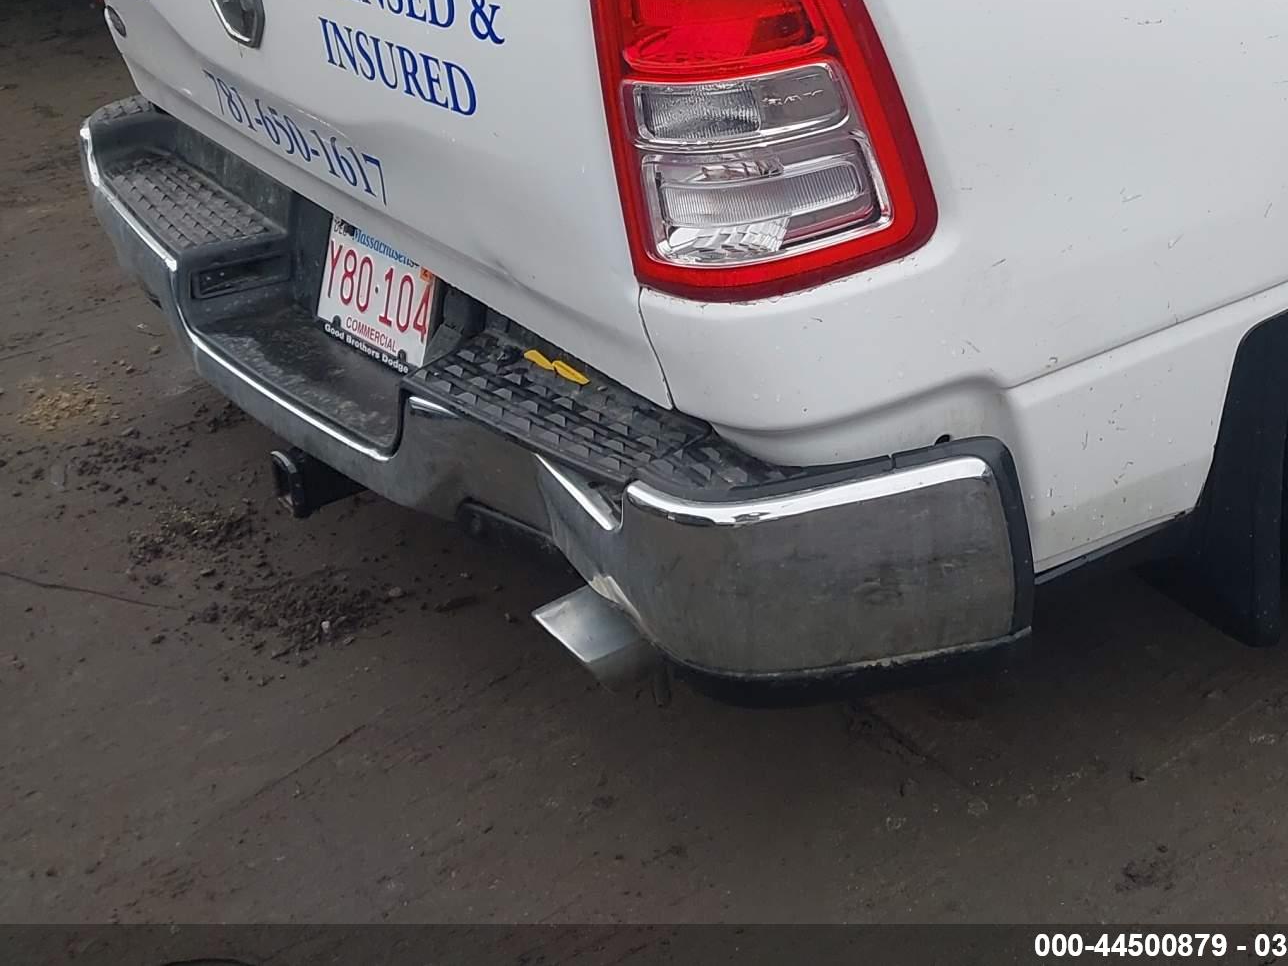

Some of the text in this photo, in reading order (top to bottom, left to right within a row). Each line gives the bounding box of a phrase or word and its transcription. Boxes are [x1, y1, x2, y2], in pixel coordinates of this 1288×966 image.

[318, 17, 477, 116] INSURED
[202, 69, 387, 207] 781-650-1617
[324, 323, 409, 374] Good Brothers Dodge
[346, 316, 398, 352] COMMERCIAL
